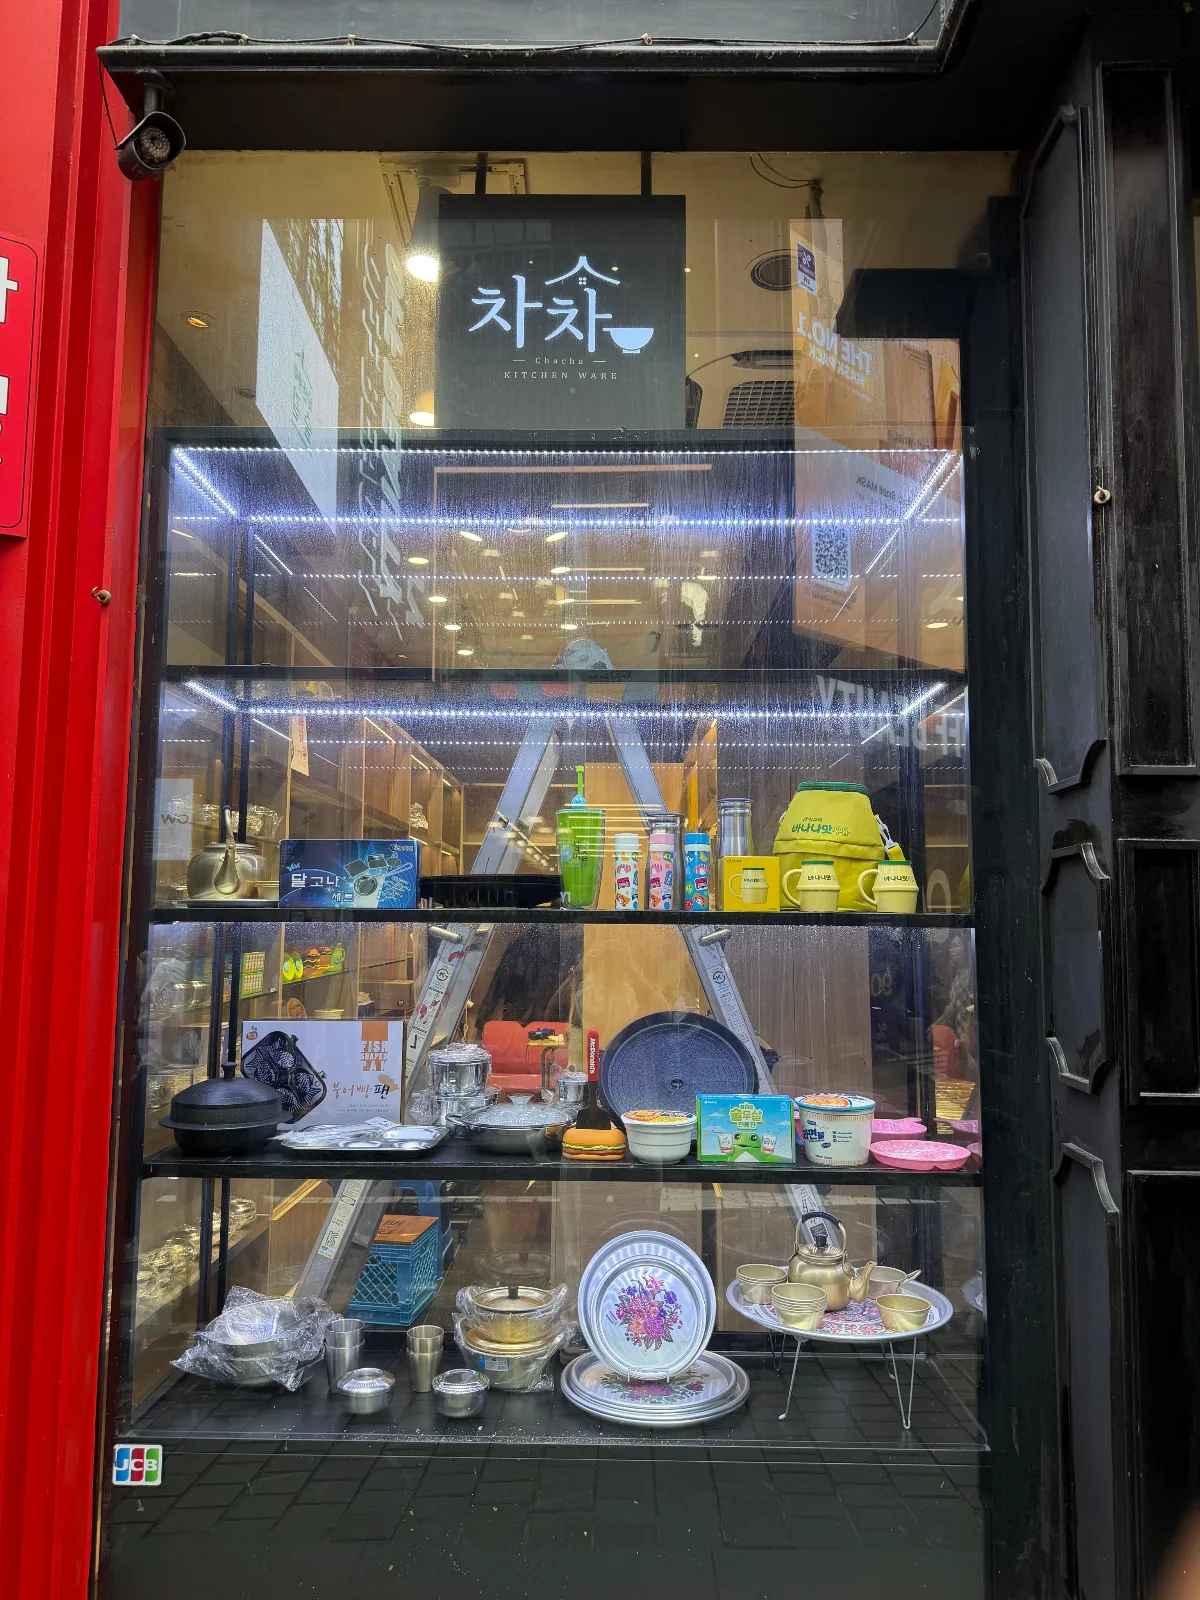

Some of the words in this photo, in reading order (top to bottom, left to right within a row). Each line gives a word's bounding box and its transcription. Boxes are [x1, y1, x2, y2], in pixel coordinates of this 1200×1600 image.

[535, 357, 584, 365] Chacha
[504, 371, 568, 379] KITCHEN
[578, 372, 618, 380] WARE
[792, 823, 832, 835] 바나나맛
[291, 873, 340, 888] 달고나
[331, 892, 355, 902] 세트
[361, 1041, 387, 1053] FISH
[361, 1053, 387, 1061] SHAPED
[332, 1082, 373, 1099] 붕어빵
[373, 1084, 391, 1100] 팬
[115, 1458, 158, 1471] JCB
